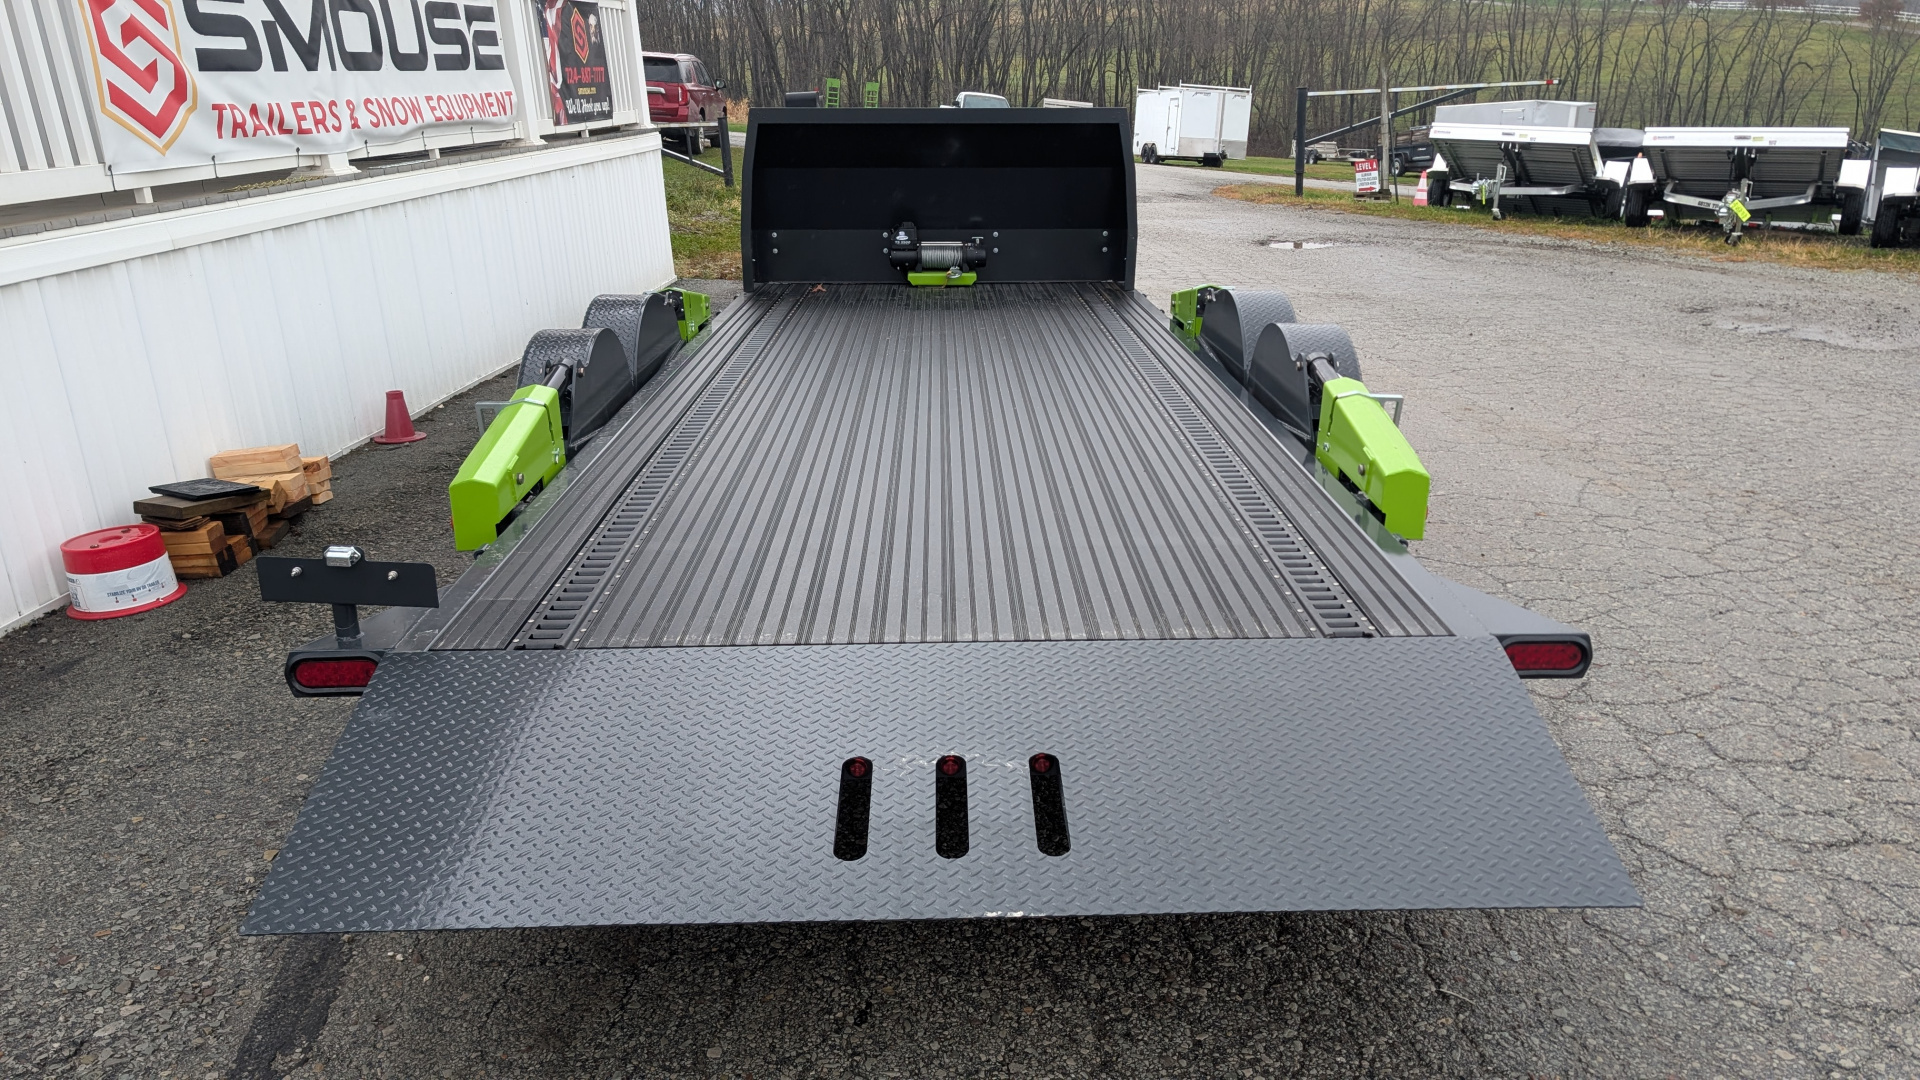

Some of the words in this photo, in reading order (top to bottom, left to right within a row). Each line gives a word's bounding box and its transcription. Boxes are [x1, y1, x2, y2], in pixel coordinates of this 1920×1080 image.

[181, 0, 506, 72] SMOUSE
[211, 99, 343, 139] TRAILERS
[345, 98, 362, 130] &
[363, 95, 425, 129] SNOW
[423, 91, 514, 123] EQUIPMENT
[1355, 162, 1372, 170] LEVEL
[1373, 161, 1377, 169] A
